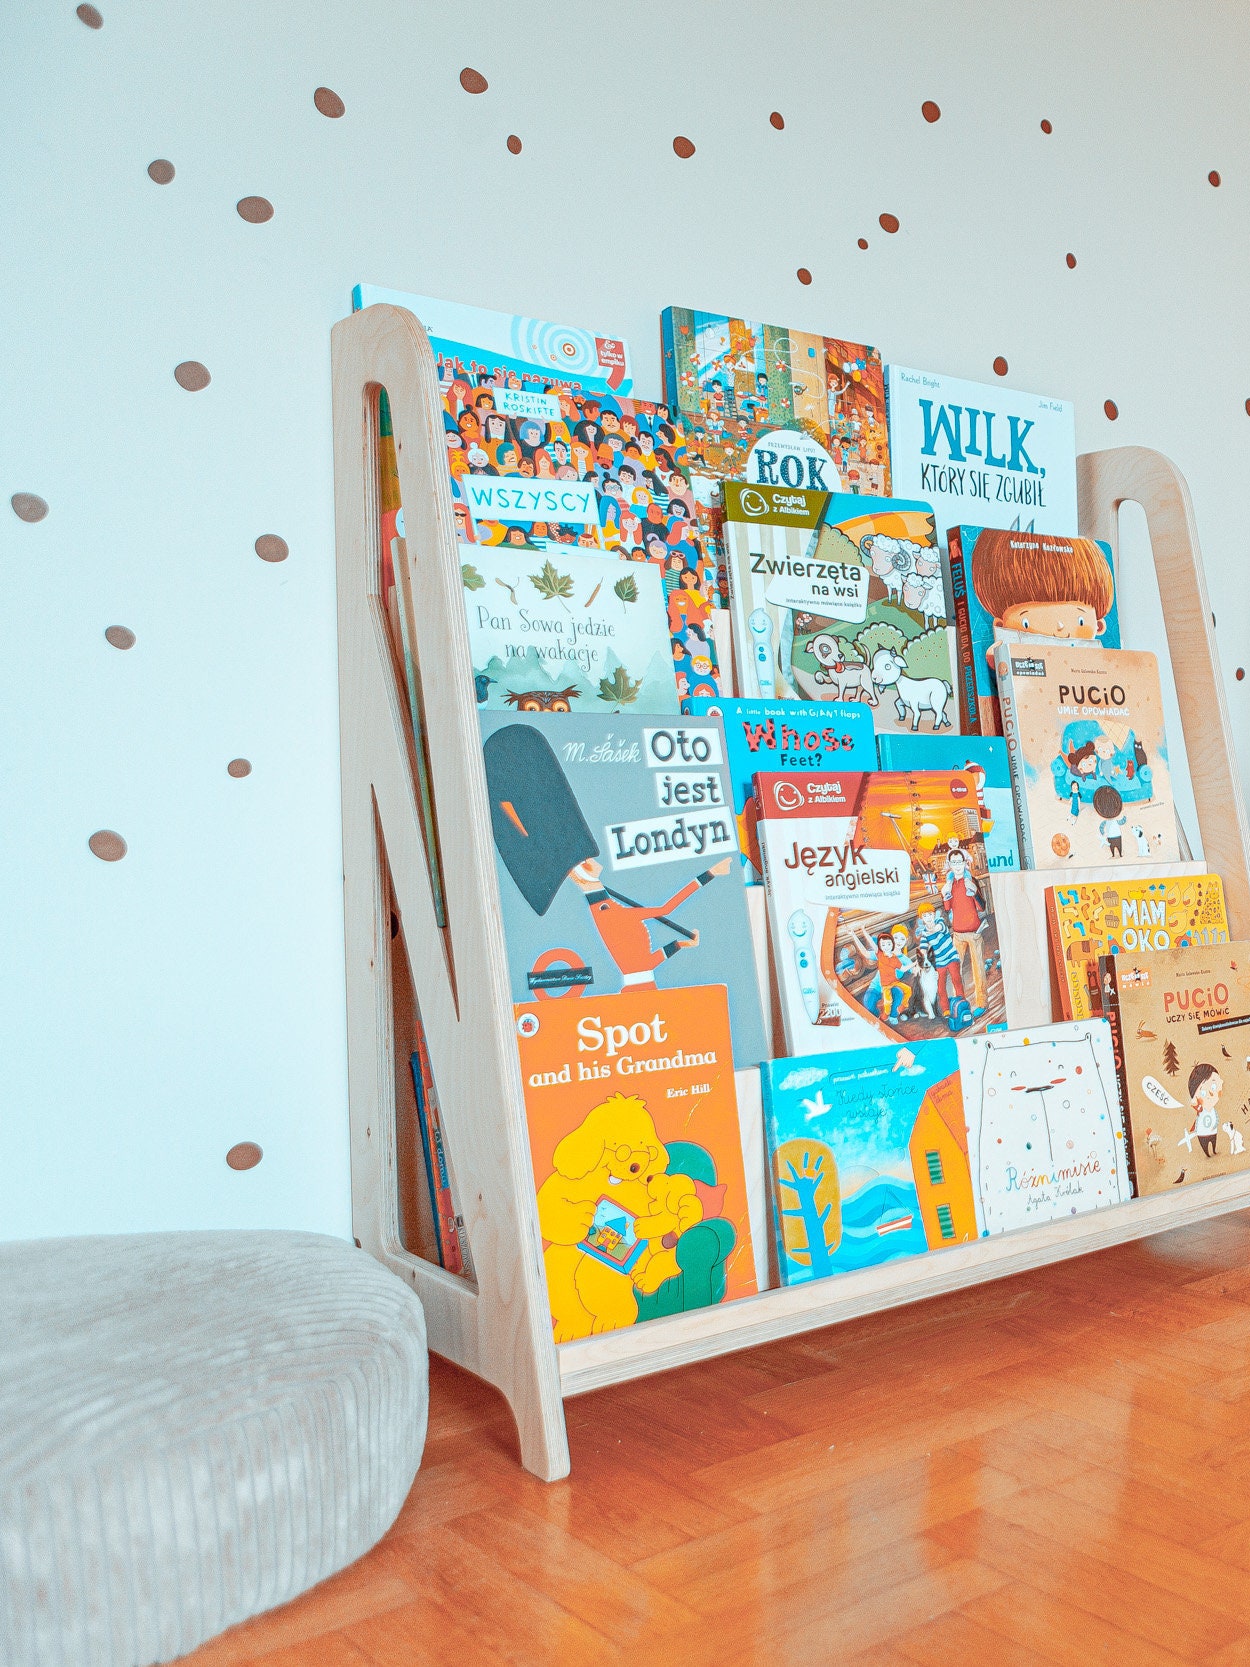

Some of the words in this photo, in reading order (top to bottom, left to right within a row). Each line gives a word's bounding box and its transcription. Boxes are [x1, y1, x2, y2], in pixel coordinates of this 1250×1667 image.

[436, 353, 464, 372] Jak
[900, 372, 921, 385] Rachel
[922, 376, 940, 389] Bright
[504, 402, 555, 416] ROSKIFTE
[505, 392, 547, 406] KRISTIN
[1050, 402, 1063, 413] Field
[918, 398, 1046, 479] WILK,
[754, 448, 829, 492] ROK
[920, 462, 966, 497] KTÓRY
[969, 470, 991, 503] SIĘ
[996, 474, 1047, 508] ZGUBIŁ
[471, 487, 590, 513] WSZYSCY
[772, 494, 806, 508] Czytaj
[780, 506, 810, 516] Albikiem
[749, 552, 862, 584] Zwierzęta
[952, 562, 967, 599] FELUŚ
[812, 584, 829, 596] na
[833, 584, 859, 598] wsi
[476, 605, 512, 631] Pan
[518, 608, 564, 634] Sowa
[566, 616, 616, 646] jedzie
[504, 642, 526, 659] na
[534, 638, 599, 672] wakacje
[736, 706, 742, 714] A
[764, 707, 786, 716] book
[790, 708, 808, 717] with
[840, 709, 860, 719] flaps
[650, 730, 712, 762] Oto
[742, 718, 854, 752] Whose
[780, 752, 822, 766] Feet?
[660, 775, 722, 806] jest
[806, 781, 842, 795] Czytaj
[808, 796, 814, 804] z
[814, 795, 846, 803] Albikiem
[610, 818, 732, 860] Londyn
[784, 839, 868, 876] Język
[825, 867, 900, 890] angielski
[1121, 898, 1166, 927] MAM
[1122, 928, 1171, 952] OKO
[1166, 1014, 1186, 1024] UCZY
[576, 1012, 668, 1057] Spot
[528, 1063, 572, 1088] and
[578, 1060, 612, 1082] his
[616, 1050, 718, 1076] Grandma
[666, 1088, 688, 1100] Eric
[691, 1083, 711, 1096] Hill
